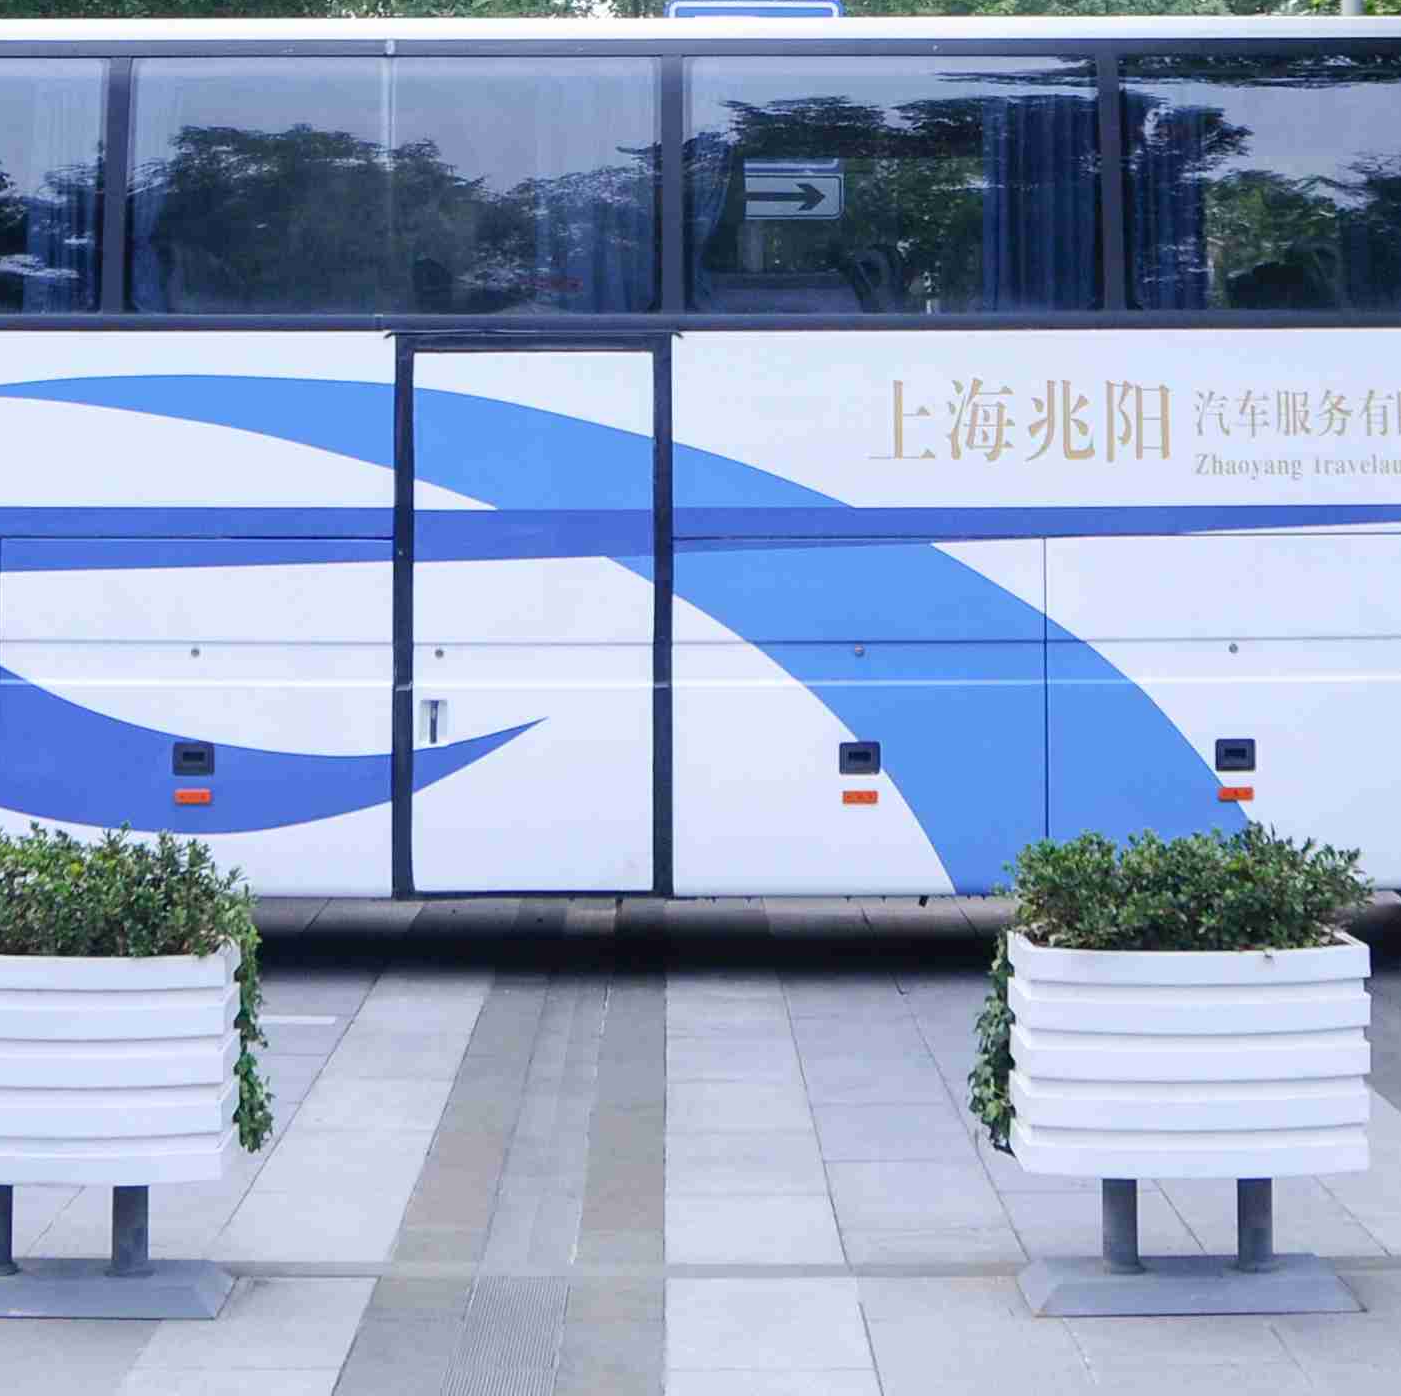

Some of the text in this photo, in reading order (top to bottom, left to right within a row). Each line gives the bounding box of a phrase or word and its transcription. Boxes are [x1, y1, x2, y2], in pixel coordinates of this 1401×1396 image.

[869, 378, 1172, 463] 上海兆阳
[1195, 452, 1304, 481] Zhaoyang
